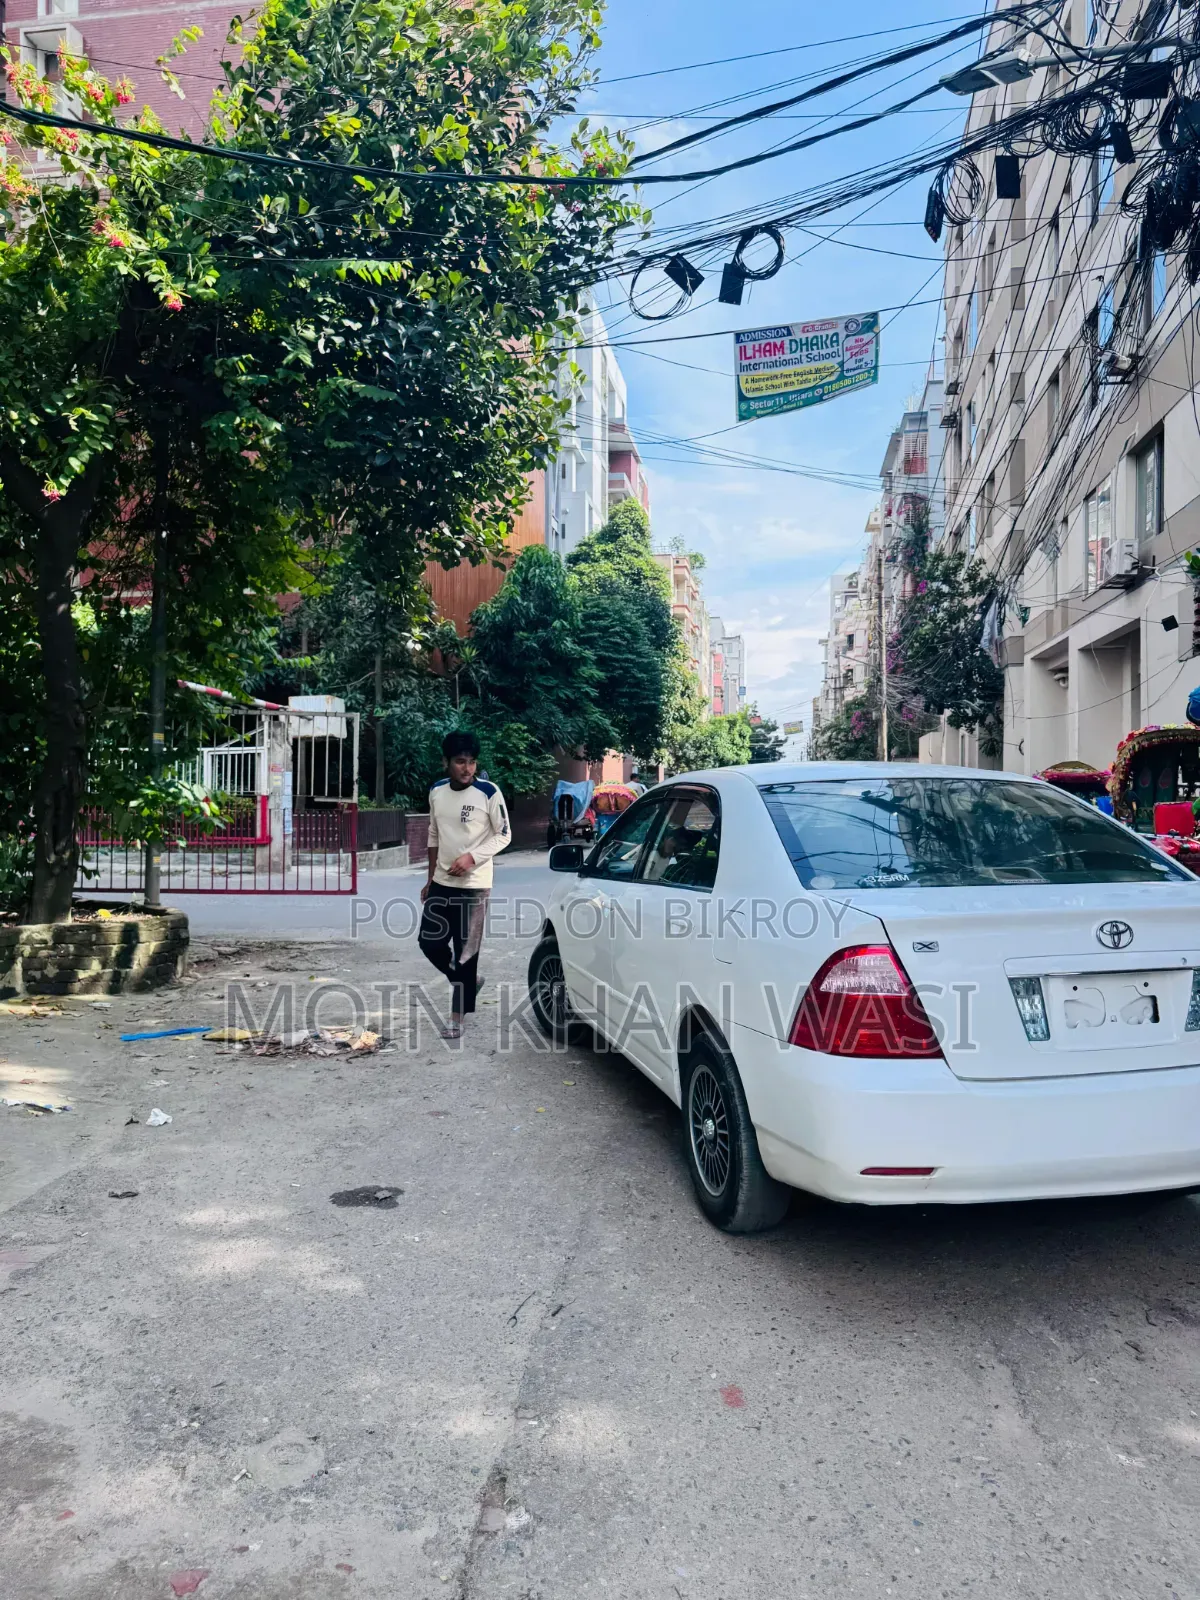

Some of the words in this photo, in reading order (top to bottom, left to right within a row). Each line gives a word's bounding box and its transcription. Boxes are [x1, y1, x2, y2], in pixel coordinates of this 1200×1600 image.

[739, 328, 788, 342] ADMISSION
[739, 340, 785, 361] ILHAM
[789, 332, 839, 353] DHAKA
[740, 354, 803, 373] International
[806, 348, 841, 363] School
[750, 400, 774, 410] Sector
